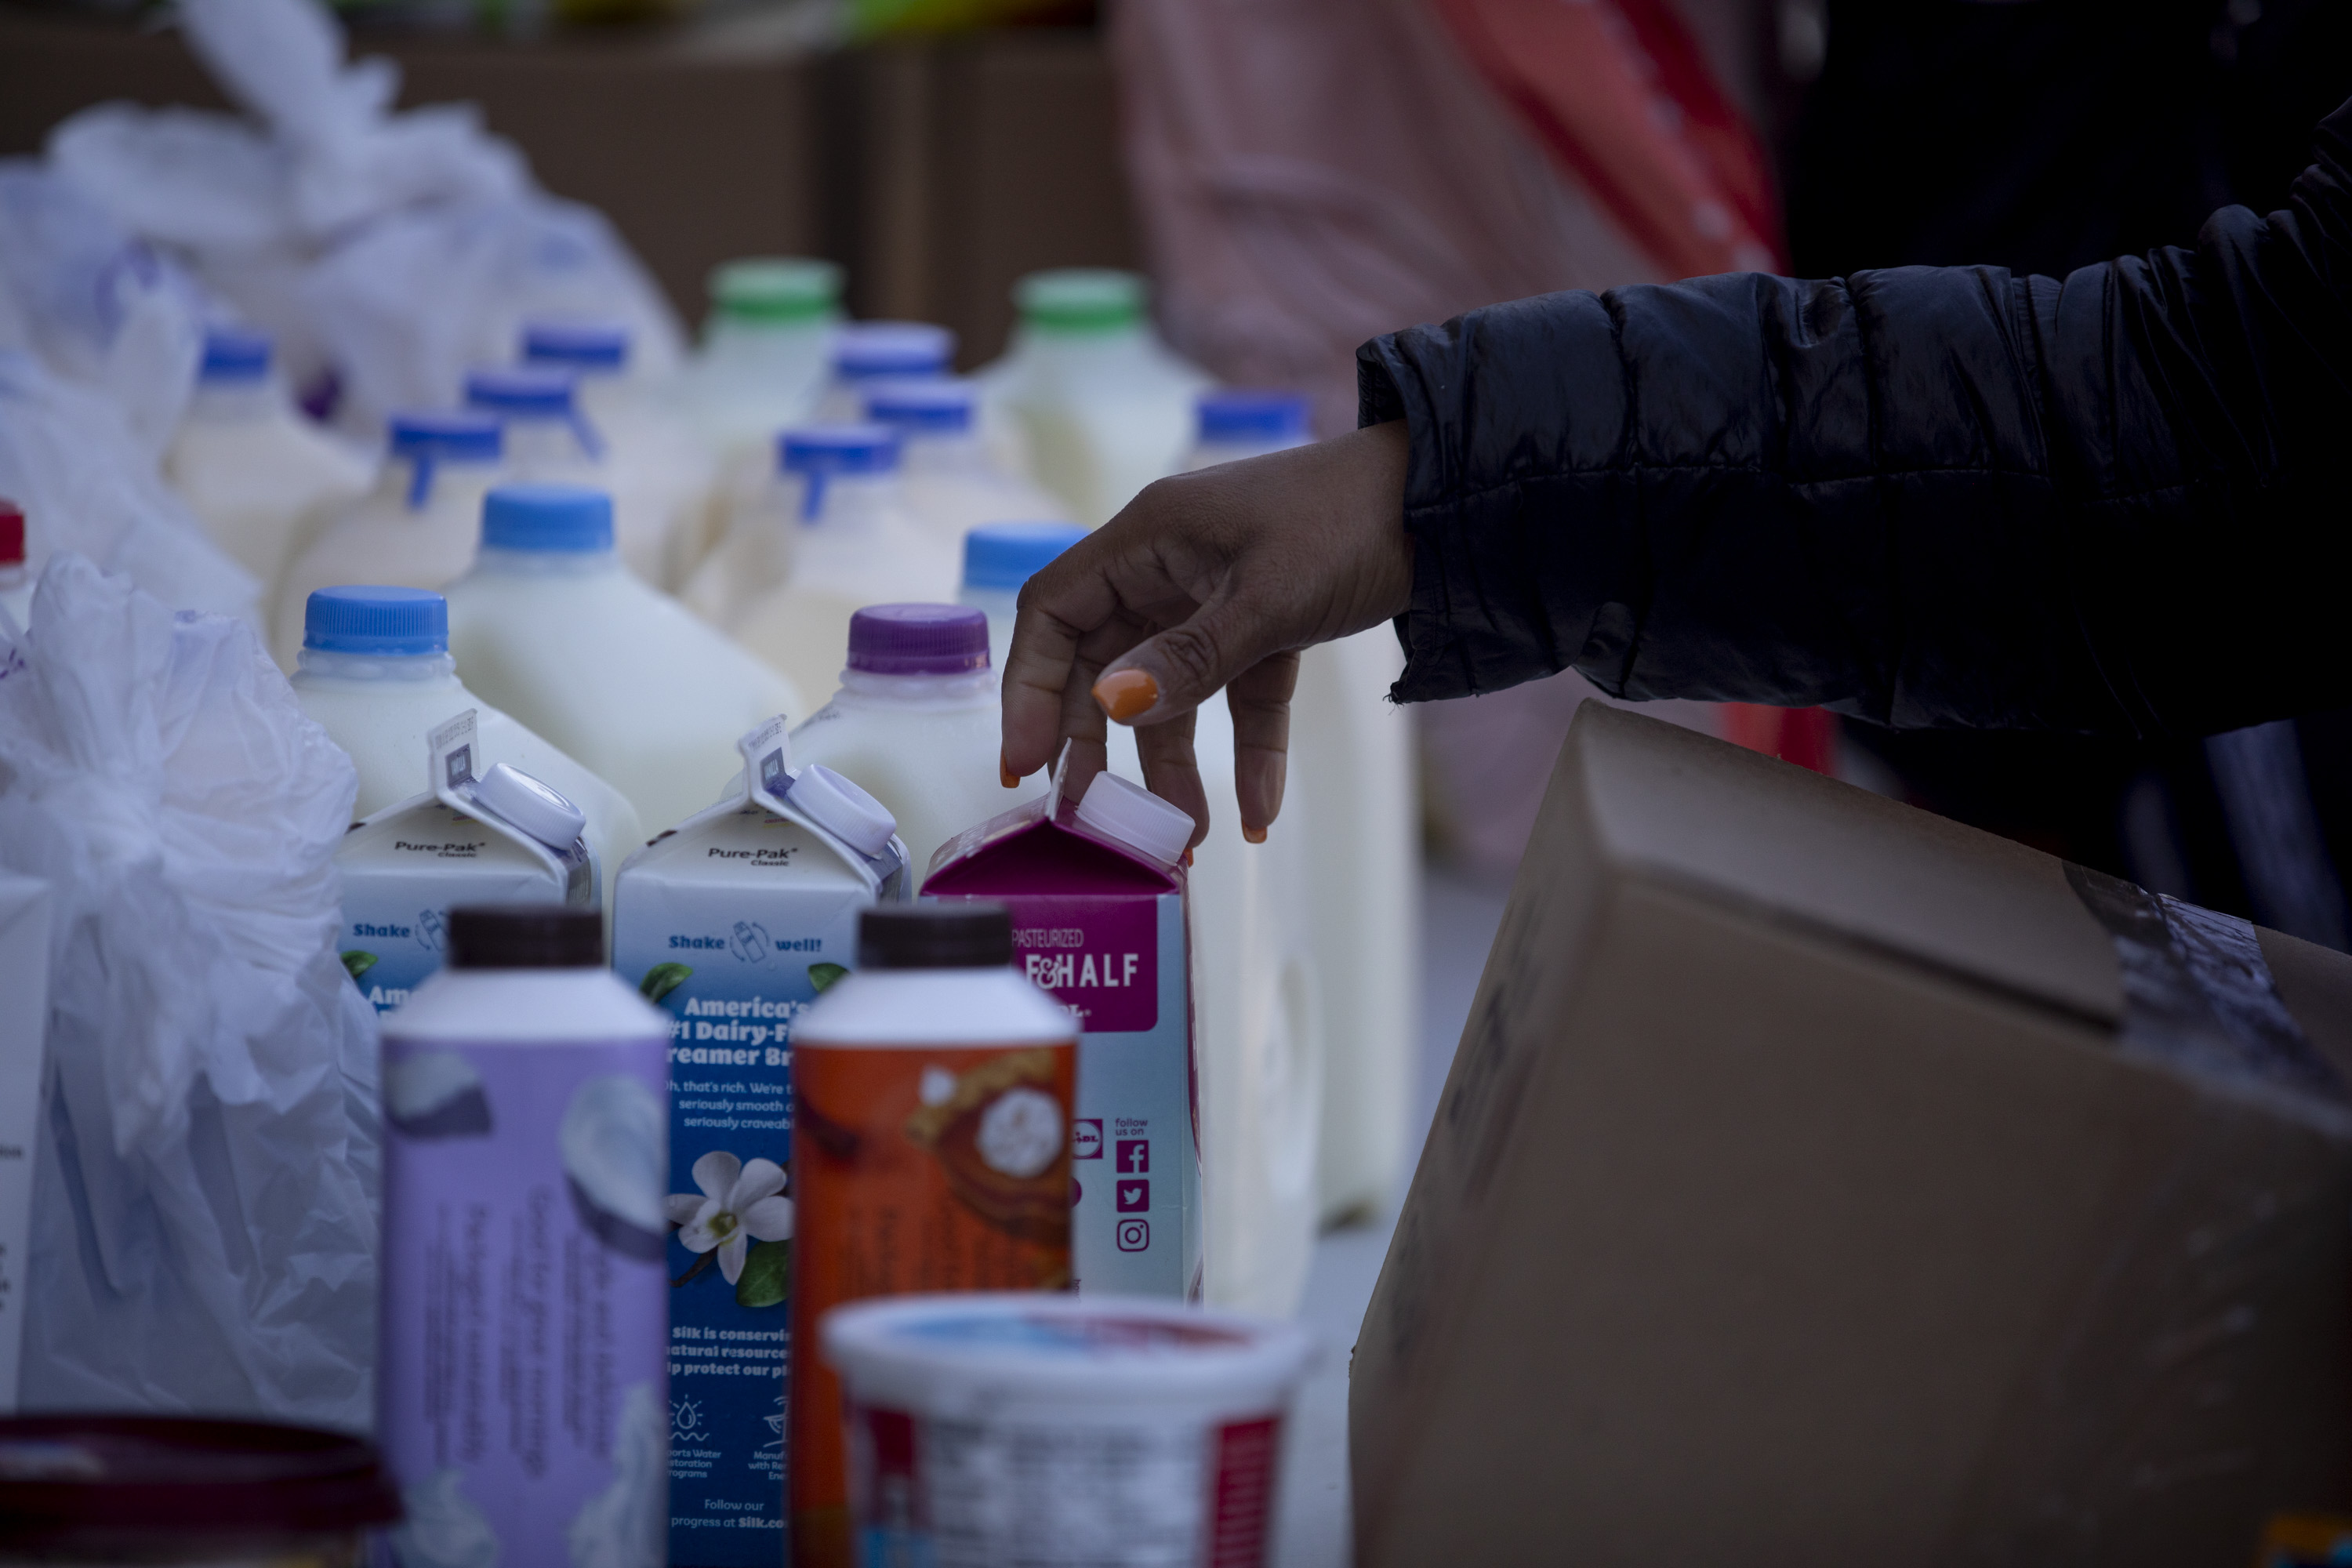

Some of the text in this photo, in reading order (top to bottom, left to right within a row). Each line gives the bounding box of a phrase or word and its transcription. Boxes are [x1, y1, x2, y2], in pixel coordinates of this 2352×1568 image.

[353, 924, 411, 937] Shake
[669, 935, 822, 952] Shake well!
[1011, 928, 1083, 948] PASTEURIZED
[684, 996, 808, 1018] America's
[684, 1080, 719, 1093] that's
[720, 1081, 748, 1094] rich.
[750, 1082, 783, 1094] We're
[679, 1098, 734, 1112] seriously
[735, 1100, 783, 1112] smooth
[684, 1116, 739, 1131] seriously
[1115, 1118, 1148, 1127] follow
[673, 1326, 701, 1339] Silk
[703, 1327, 717, 1339] is
[684, 1363, 740, 1376] protect
[742, 1366, 770, 1376] our
[692, 1450, 721, 1459] Water
[666, 1459, 713, 1468] storation
[748, 1461, 770, 1470] with
[705, 1499, 742, 1510] Follow
[671, 1517, 721, 1528] progress
